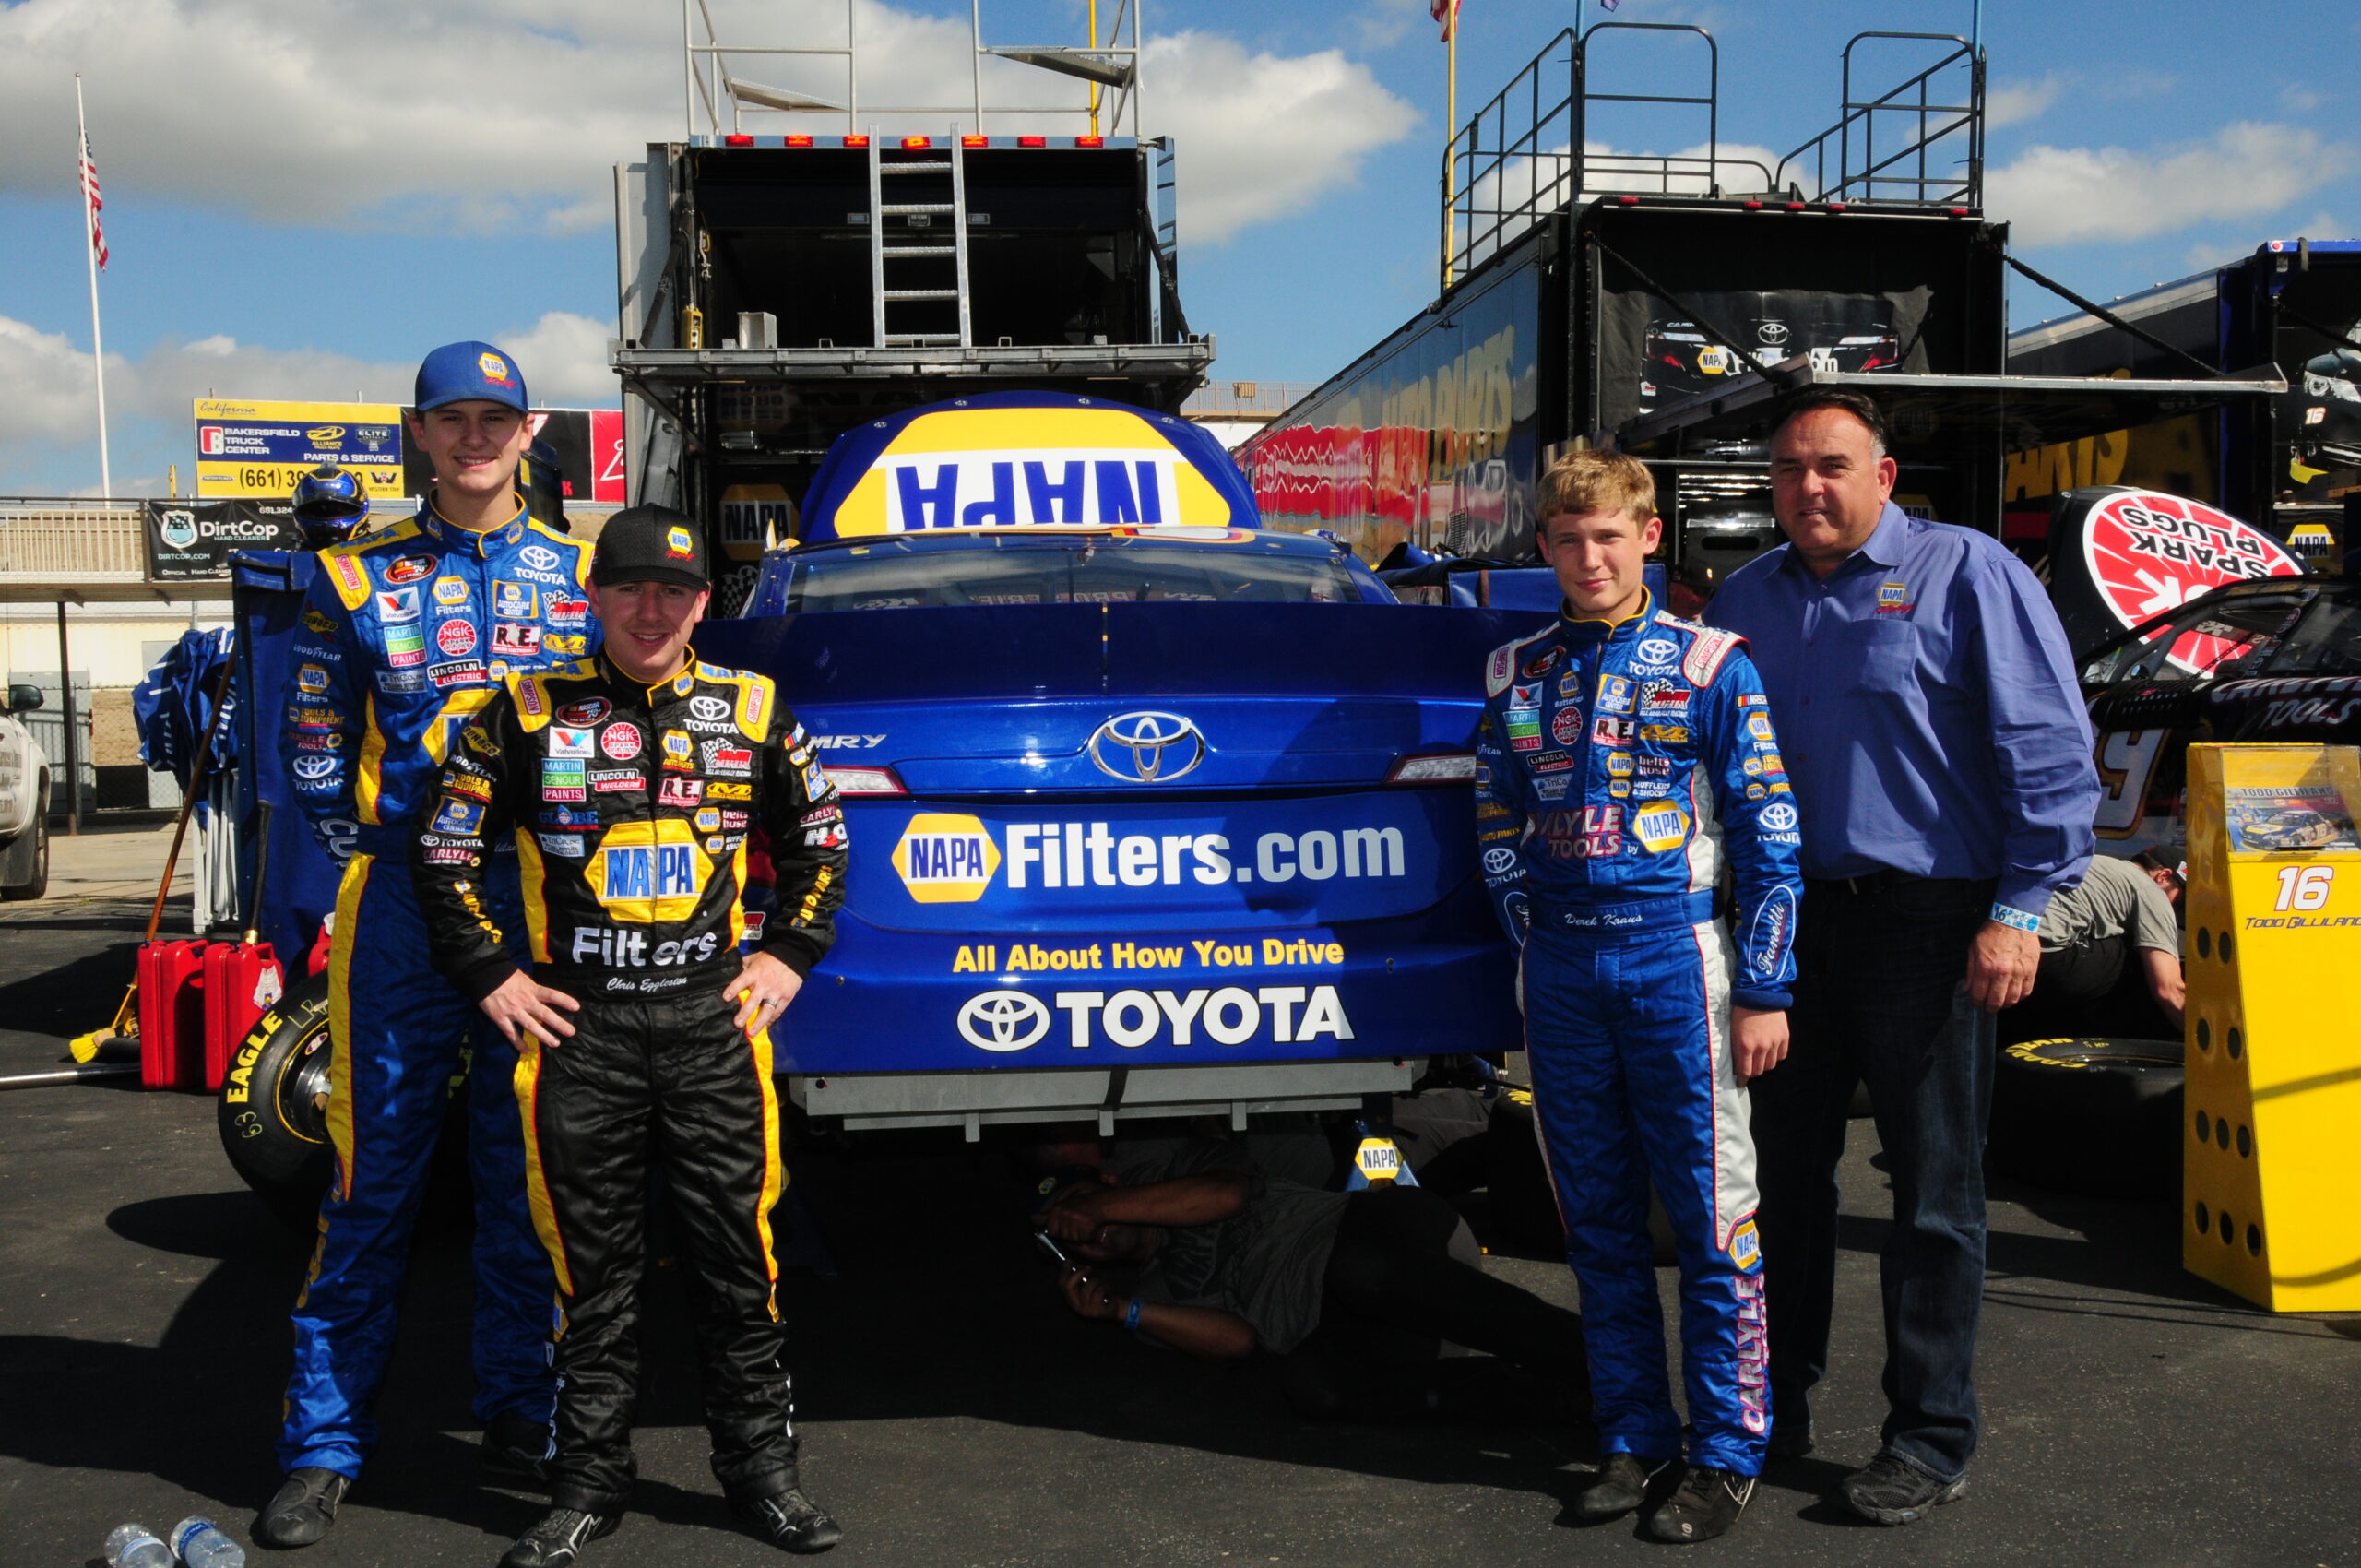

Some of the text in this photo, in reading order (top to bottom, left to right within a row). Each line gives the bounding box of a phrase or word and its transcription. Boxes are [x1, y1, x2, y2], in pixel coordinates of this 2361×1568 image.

[483, 358, 505, 373] NAPA
[200, 402, 255, 416] California
[224, 427, 301, 437] BAKERSFIELD
[224, 437, 264, 445] TRUCK
[224, 446, 270, 455] CENTER
[303, 453, 395, 463] PARTS & SERVICE
[240, 467, 281, 490] (661)
[895, 460, 1163, 531] NAPA
[724, 505, 789, 540] NAPA
[200, 520, 279, 540] DirtCop
[2122, 506, 2261, 558] PLUGS
[671, 532, 690, 548] NAPA
[2294, 535, 2328, 557] NAPA
[2130, 531, 2270, 579] SPARK
[336, 555, 360, 588] SIMPSON
[514, 567, 567, 586] TOYOTA
[438, 585, 464, 598] NAPA
[1881, 589, 1902, 600] NAPA
[435, 604, 471, 615] Filters
[387, 624, 421, 638] MARTIN
[443, 627, 469, 636] NGK
[392, 651, 425, 665] PAINTS
[429, 662, 478, 678] LINCOLN
[492, 666, 505, 675] NAPA
[1629, 661, 1680, 676] TOYOTA
[303, 669, 326, 687] NAPA
[442, 672, 482, 683] ELECTRIC
[676, 676, 691, 691] NAPA
[1561, 677, 1578, 691] NAPA
[296, 692, 328, 703] Filters
[521, 681, 540, 711] SIMPSON
[748, 688, 765, 722] SIMPSON
[301, 708, 326, 717] TOOLS
[1506, 712, 1539, 723] MARTIN
[1557, 715, 1578, 724] NGK
[300, 715, 346, 725] EQUIPMENT
[682, 719, 740, 734] TOYOTA
[463, 726, 500, 756] SUNOCO
[608, 731, 634, 741] NGK
[668, 736, 688, 754] NAPA
[544, 762, 581, 771] MARTIN
[1529, 754, 1565, 765] LINCOLN
[1539, 761, 1569, 771] ELECTRIC
[1610, 759, 1631, 770] NAPA
[1746, 762, 1759, 771] NAPA
[292, 776, 345, 790] TOYOTA
[457, 771, 480, 784] TOOLS
[545, 776, 581, 784] SENOUR
[590, 771, 635, 781] LINCOLN
[600, 781, 641, 790] WELDERS
[1613, 782, 1629, 792] NAPA
[1633, 781, 1670, 790] MUFFLERS
[2242, 787, 2336, 798] TODD GILLILAND
[545, 789, 582, 799] PAINTS
[1749, 789, 1762, 797] NAPA
[699, 814, 718, 826] NAPA
[1642, 817, 1683, 840] NAPA
[441, 838, 484, 848] TOYOTA
[1549, 834, 1621, 858] TOOLS
[1627, 844, 1638, 854] by
[423, 848, 473, 861] CARLYLE
[910, 821, 1406, 888] NAPA Filters.com
[605, 846, 693, 897] NAPA
[2274, 866, 2334, 911] 16
[1564, 912, 1643, 926] Derek Kraus
[572, 926, 718, 968] Filters
[953, 937, 1345, 972] All About How You Drive
[606, 976, 688, 992] Chris Eggleston
[1055, 984, 1358, 1049] TOYOTA
[227, 1010, 283, 1103] EAGLE
[1363, 1149, 1396, 1168] NAPA
[1736, 1229, 1758, 1258] NAPA
[1734, 1274, 1767, 1435] CARLYLE
